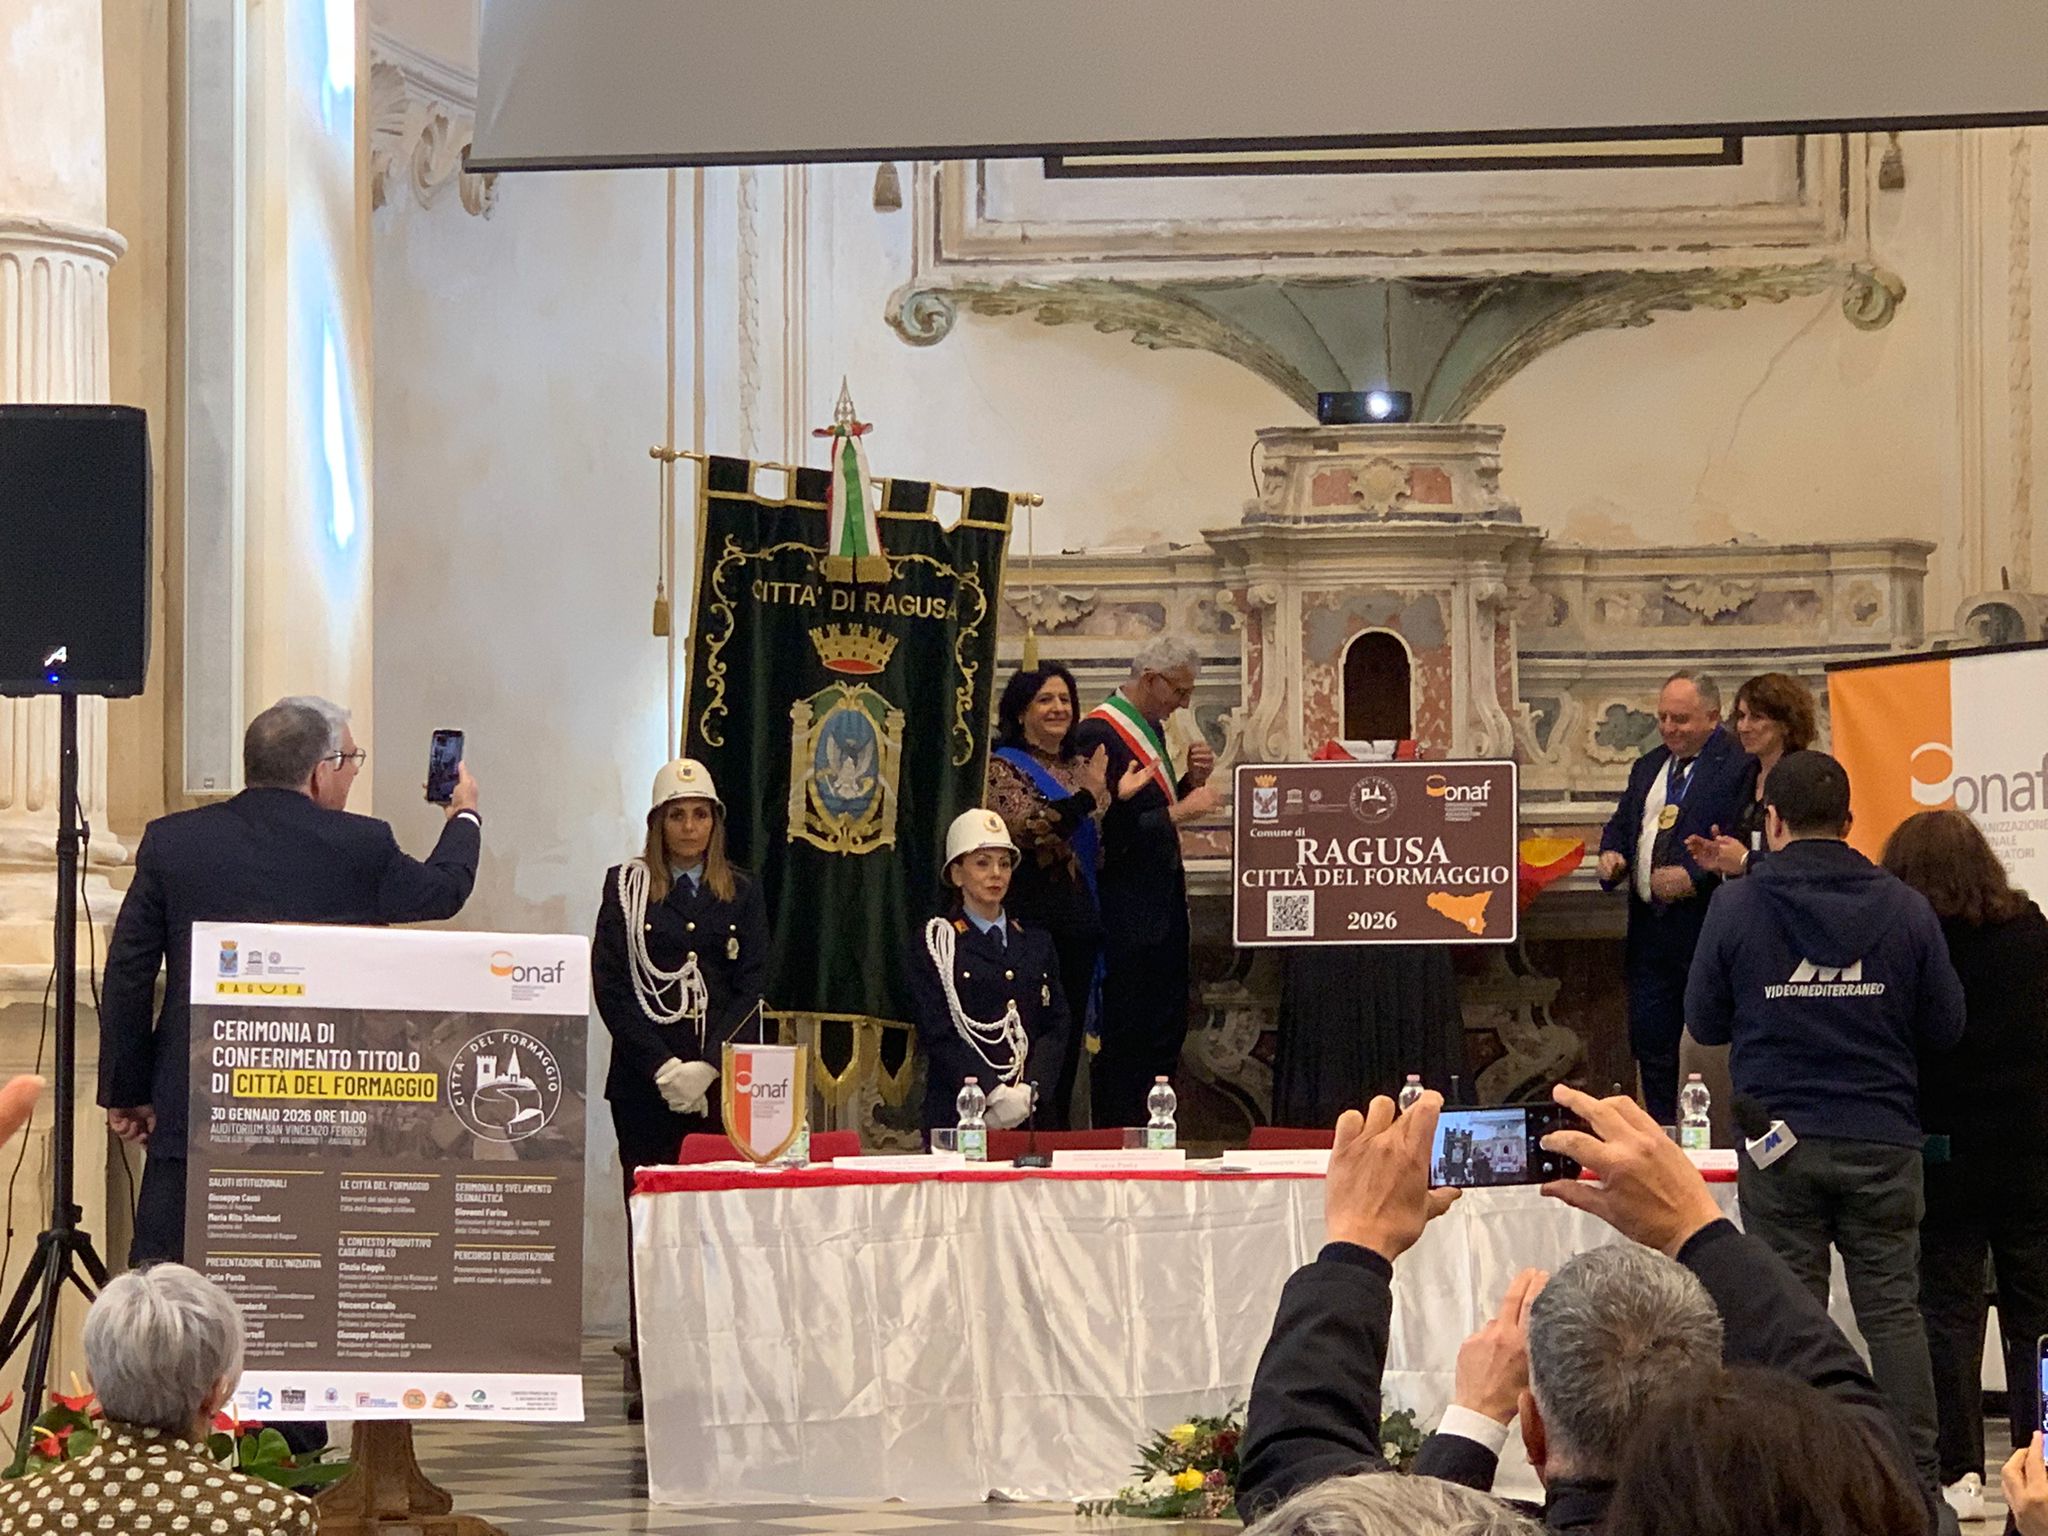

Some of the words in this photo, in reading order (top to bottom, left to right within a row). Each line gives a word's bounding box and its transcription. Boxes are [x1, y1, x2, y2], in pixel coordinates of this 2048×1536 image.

[752, 579, 822, 607] CITTA'
[831, 589, 856, 613] DI
[864, 591, 958, 621] RAGUSA
[1445, 779, 1492, 801] onaf
[1250, 828, 1293, 838] Comune
[1295, 827, 1306, 837] di
[1296, 837, 1451, 867] RAGUSA
[1242, 864, 1307, 887] CITTÀ
[1314, 868, 1359, 886] DEL
[1365, 866, 1510, 887] FORMAGGIO
[1347, 912, 1398, 930] 2026
[512, 960, 565, 983] onaf
[1764, 982, 1885, 999] VIDEOMEDITERRANEO
[213, 1020, 312, 1043] CERIMONIA
[317, 1023, 335, 1044] DI
[212, 1046, 351, 1070] CONFERIMENTO
[357, 1050, 420, 1072] TITOLO
[469, 1035, 495, 1053] DEL
[503, 1033, 558, 1092] FORMAGGIO
[212, 1073, 229, 1094] DI
[237, 1070, 288, 1094] CITTÀ
[294, 1075, 328, 1095] DEL
[334, 1076, 435, 1098] FORMAGGIO
[751, 1078, 788, 1098] onaf
[211, 1107, 226, 1121] 30
[229, 1107, 280, 1122] GENNAIO
[282, 1109, 311, 1122] 2026
[315, 1109, 336, 1123] ORE
[340, 1110, 367, 1124] 11.00
[210, 1122, 263, 1135] AUDITORIUM
[266, 1124, 282, 1135] SAN
[285, 1124, 328, 1136] VINCENZO
[331, 1125, 367, 1137] FERRERI
[340, 1180, 350, 1189] LE
[374, 1181, 387, 1190] DEL
